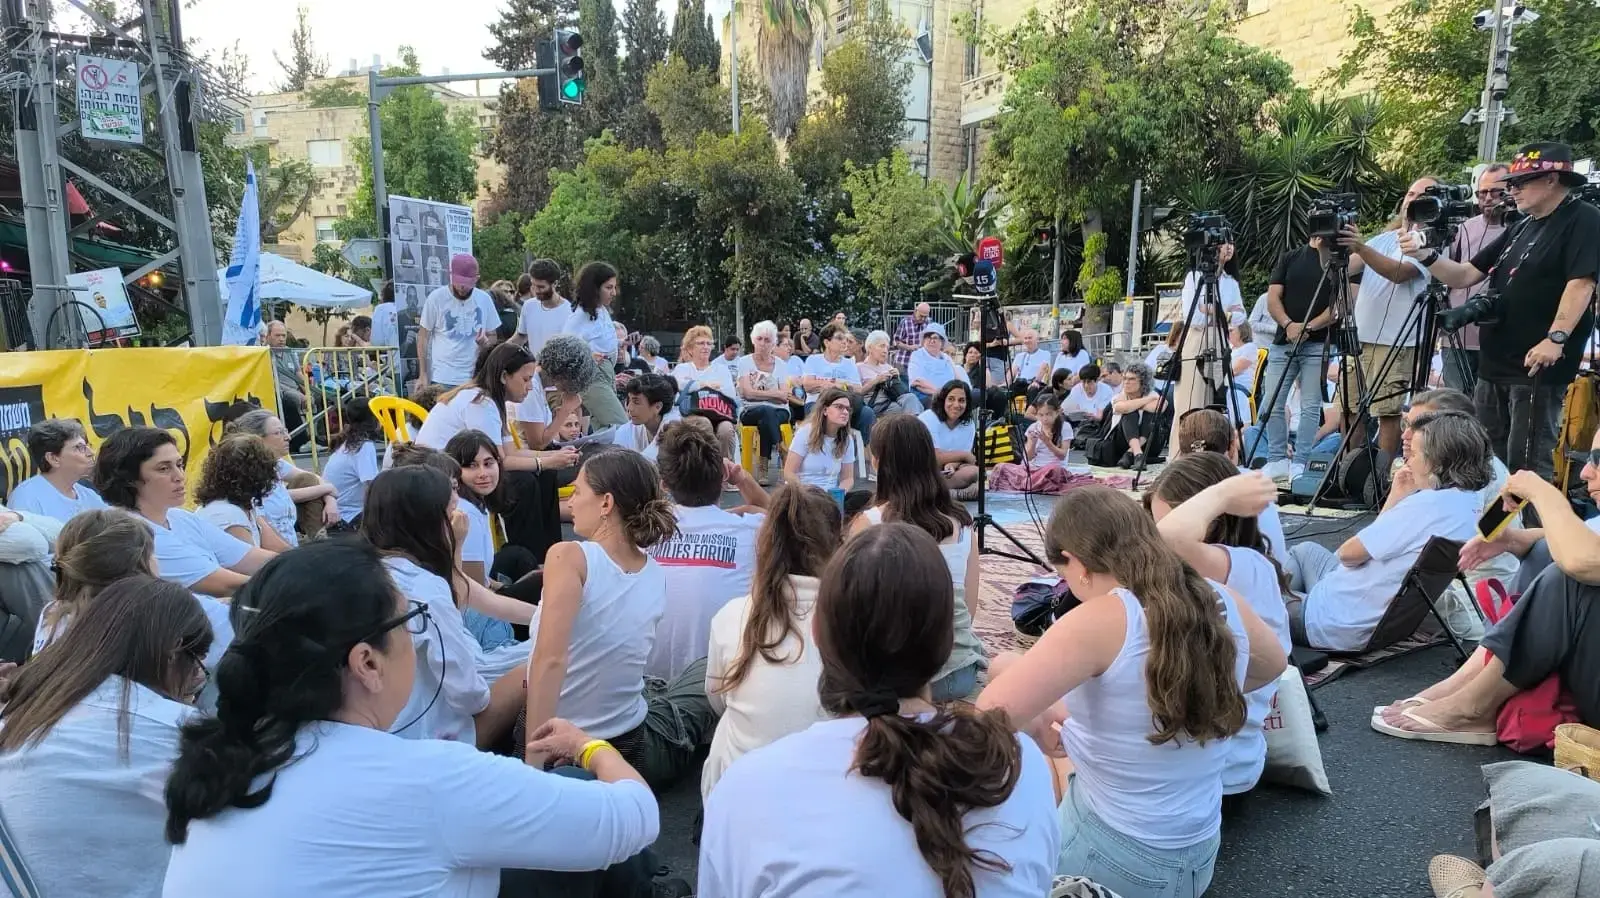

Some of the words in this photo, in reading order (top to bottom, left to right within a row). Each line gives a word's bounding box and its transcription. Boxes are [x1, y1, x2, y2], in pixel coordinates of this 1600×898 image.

[114, 93, 138, 104] מתח
[976, 275, 989, 285] 15
[701, 533, 738, 549] MISSING
[693, 544, 737, 564] FORUM
